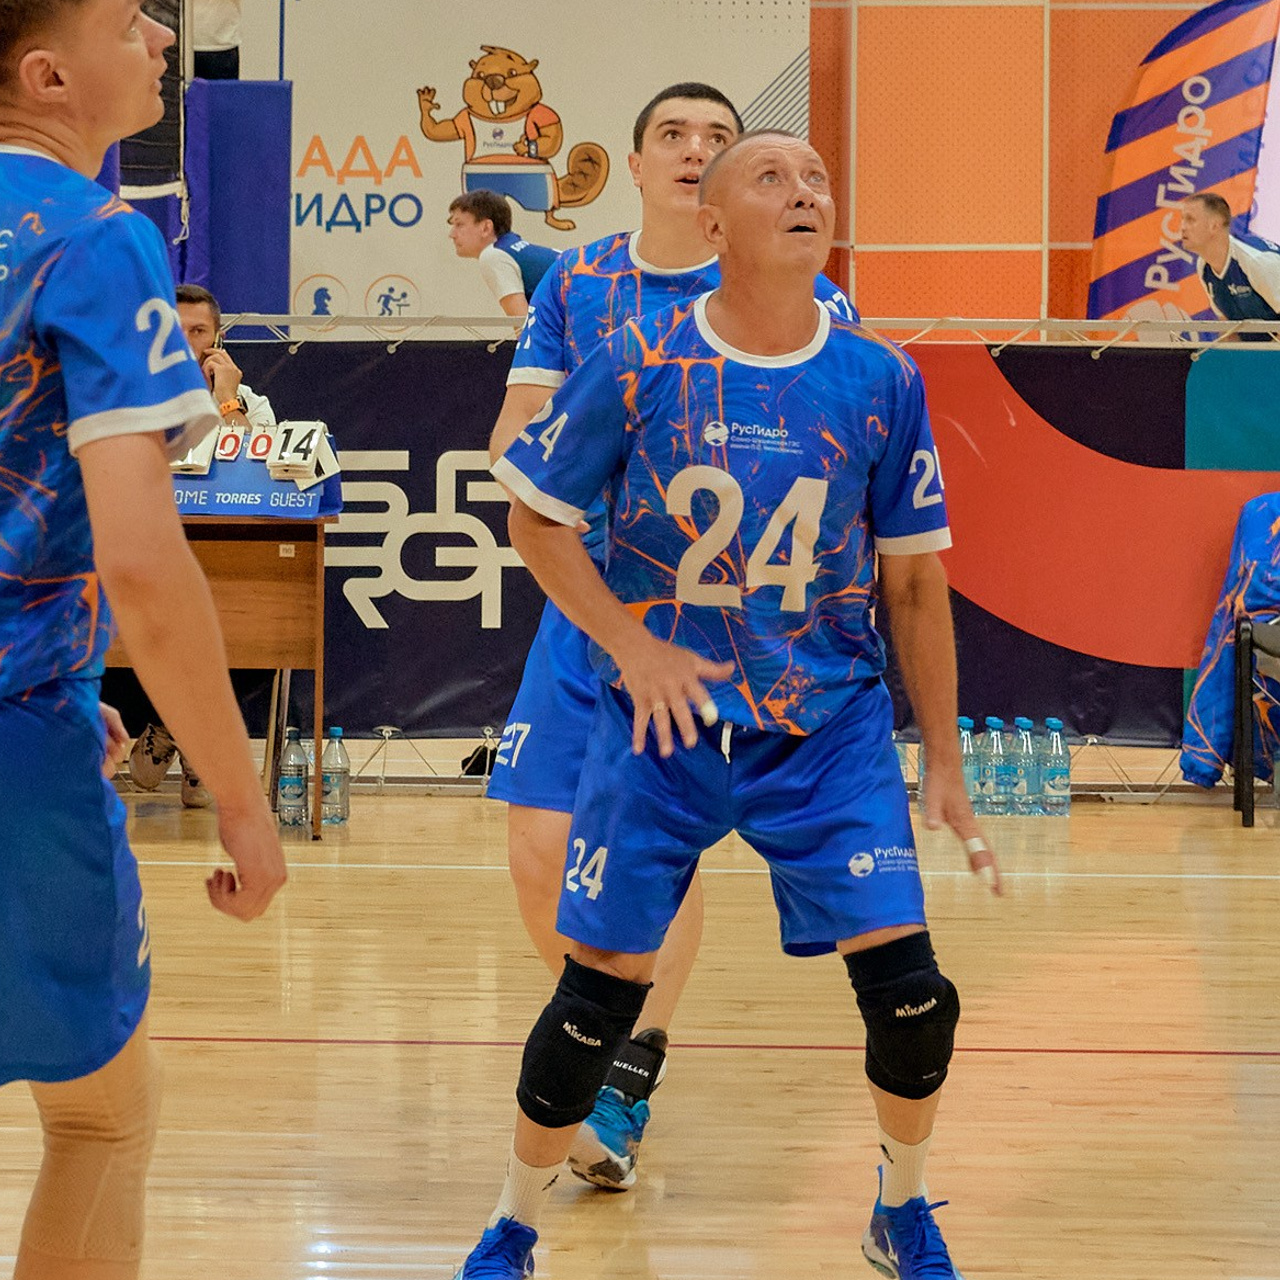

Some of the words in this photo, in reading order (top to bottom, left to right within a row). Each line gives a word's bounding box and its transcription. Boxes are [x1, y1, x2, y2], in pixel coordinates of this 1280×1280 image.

[296, 134, 423, 186] АДА
[294, 192, 423, 233] ИДРО
[135, 297, 197, 375] 2
[278, 428, 317, 461] 14
[731, 422, 789, 439] РусГидро
[174, 490, 208, 506] OME
[215, 492, 262, 505] TORRES
[270, 491, 317, 508] GUEST
[908, 445, 945, 510] 2
[665, 464, 829, 612] 24
[494, 722, 531, 768] 27
[566, 837, 608, 900] 24
